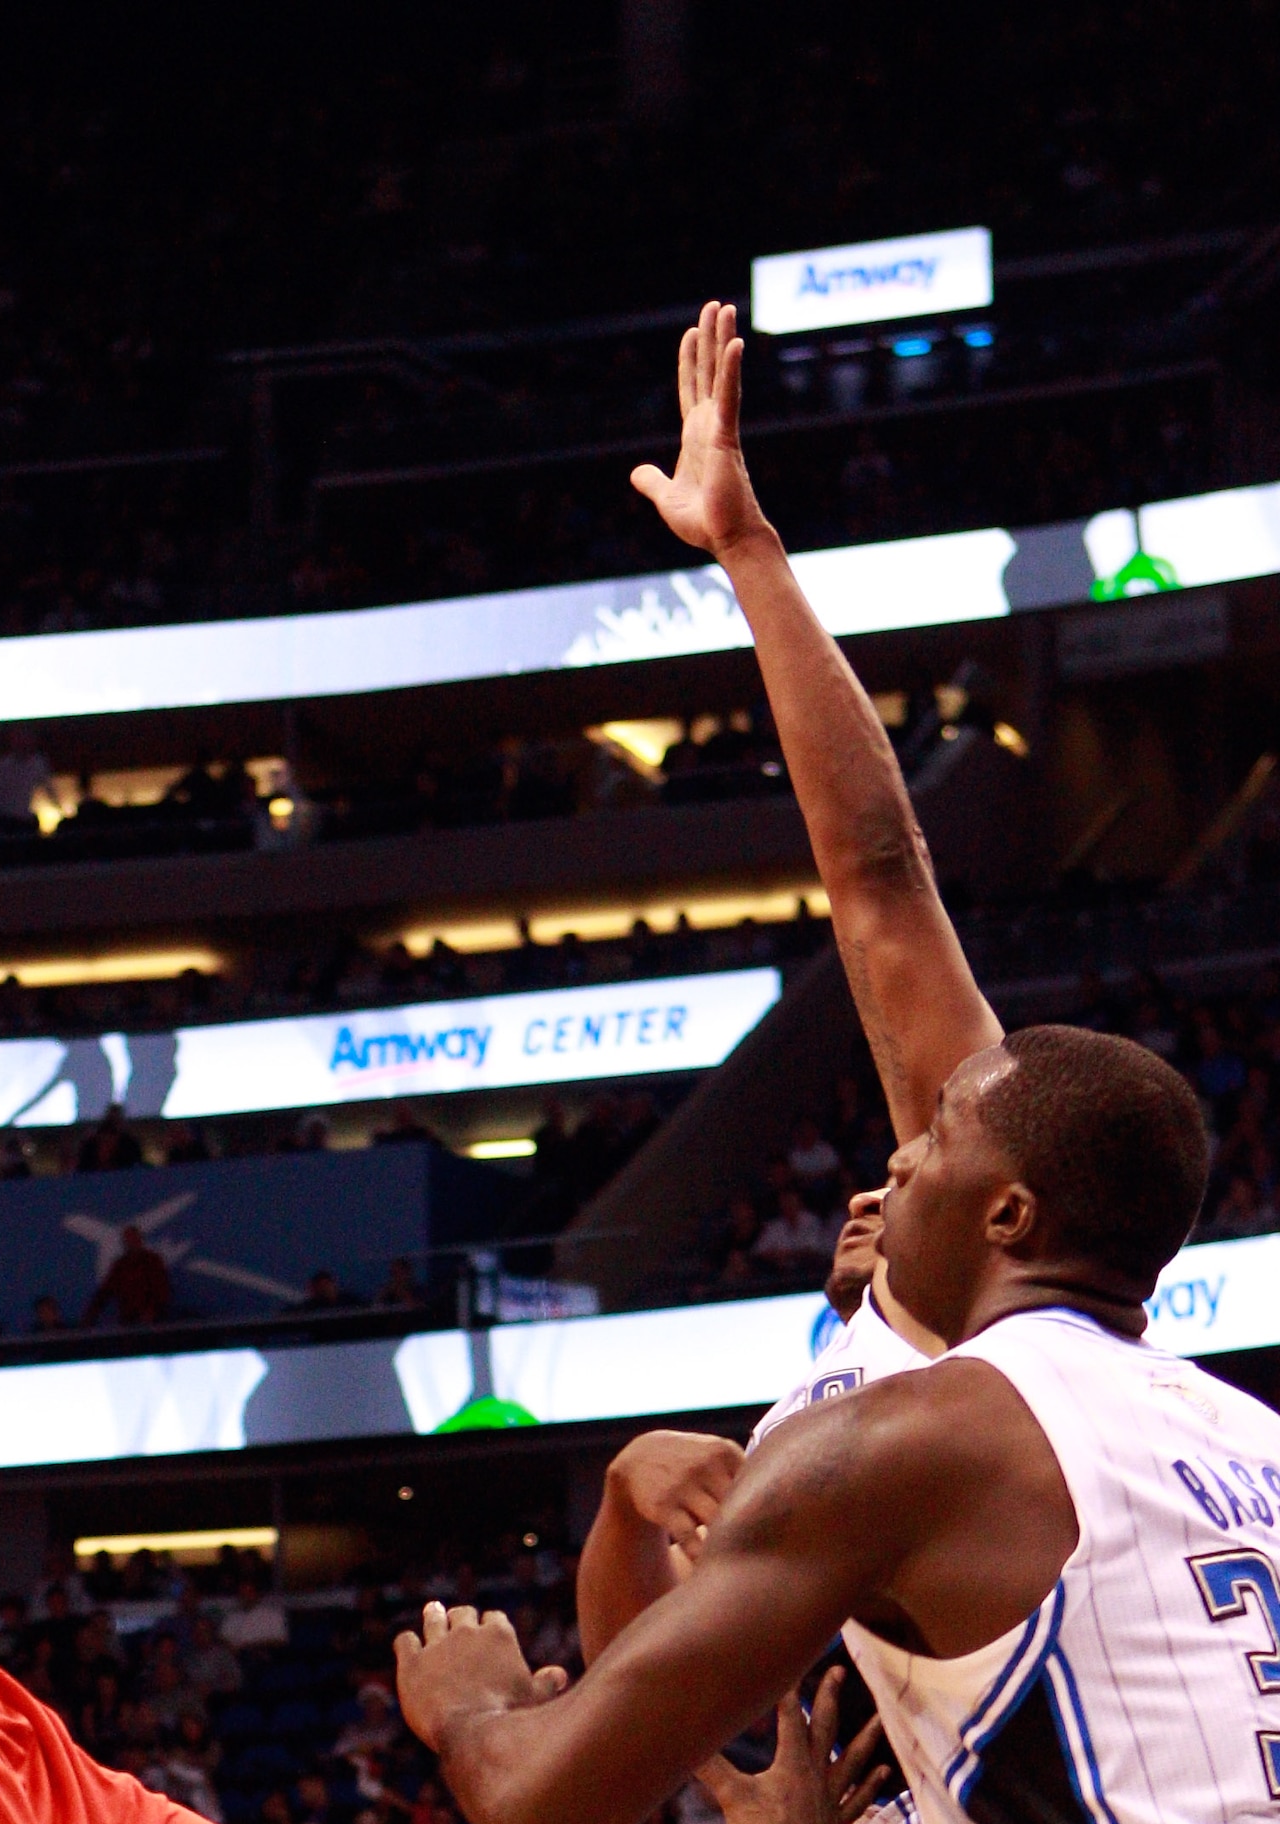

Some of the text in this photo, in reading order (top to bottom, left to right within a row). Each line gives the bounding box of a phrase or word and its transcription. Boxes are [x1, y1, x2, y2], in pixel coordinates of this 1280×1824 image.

[796, 256, 939, 298] Amway
[329, 1006, 689, 1072] Amway CENTER
